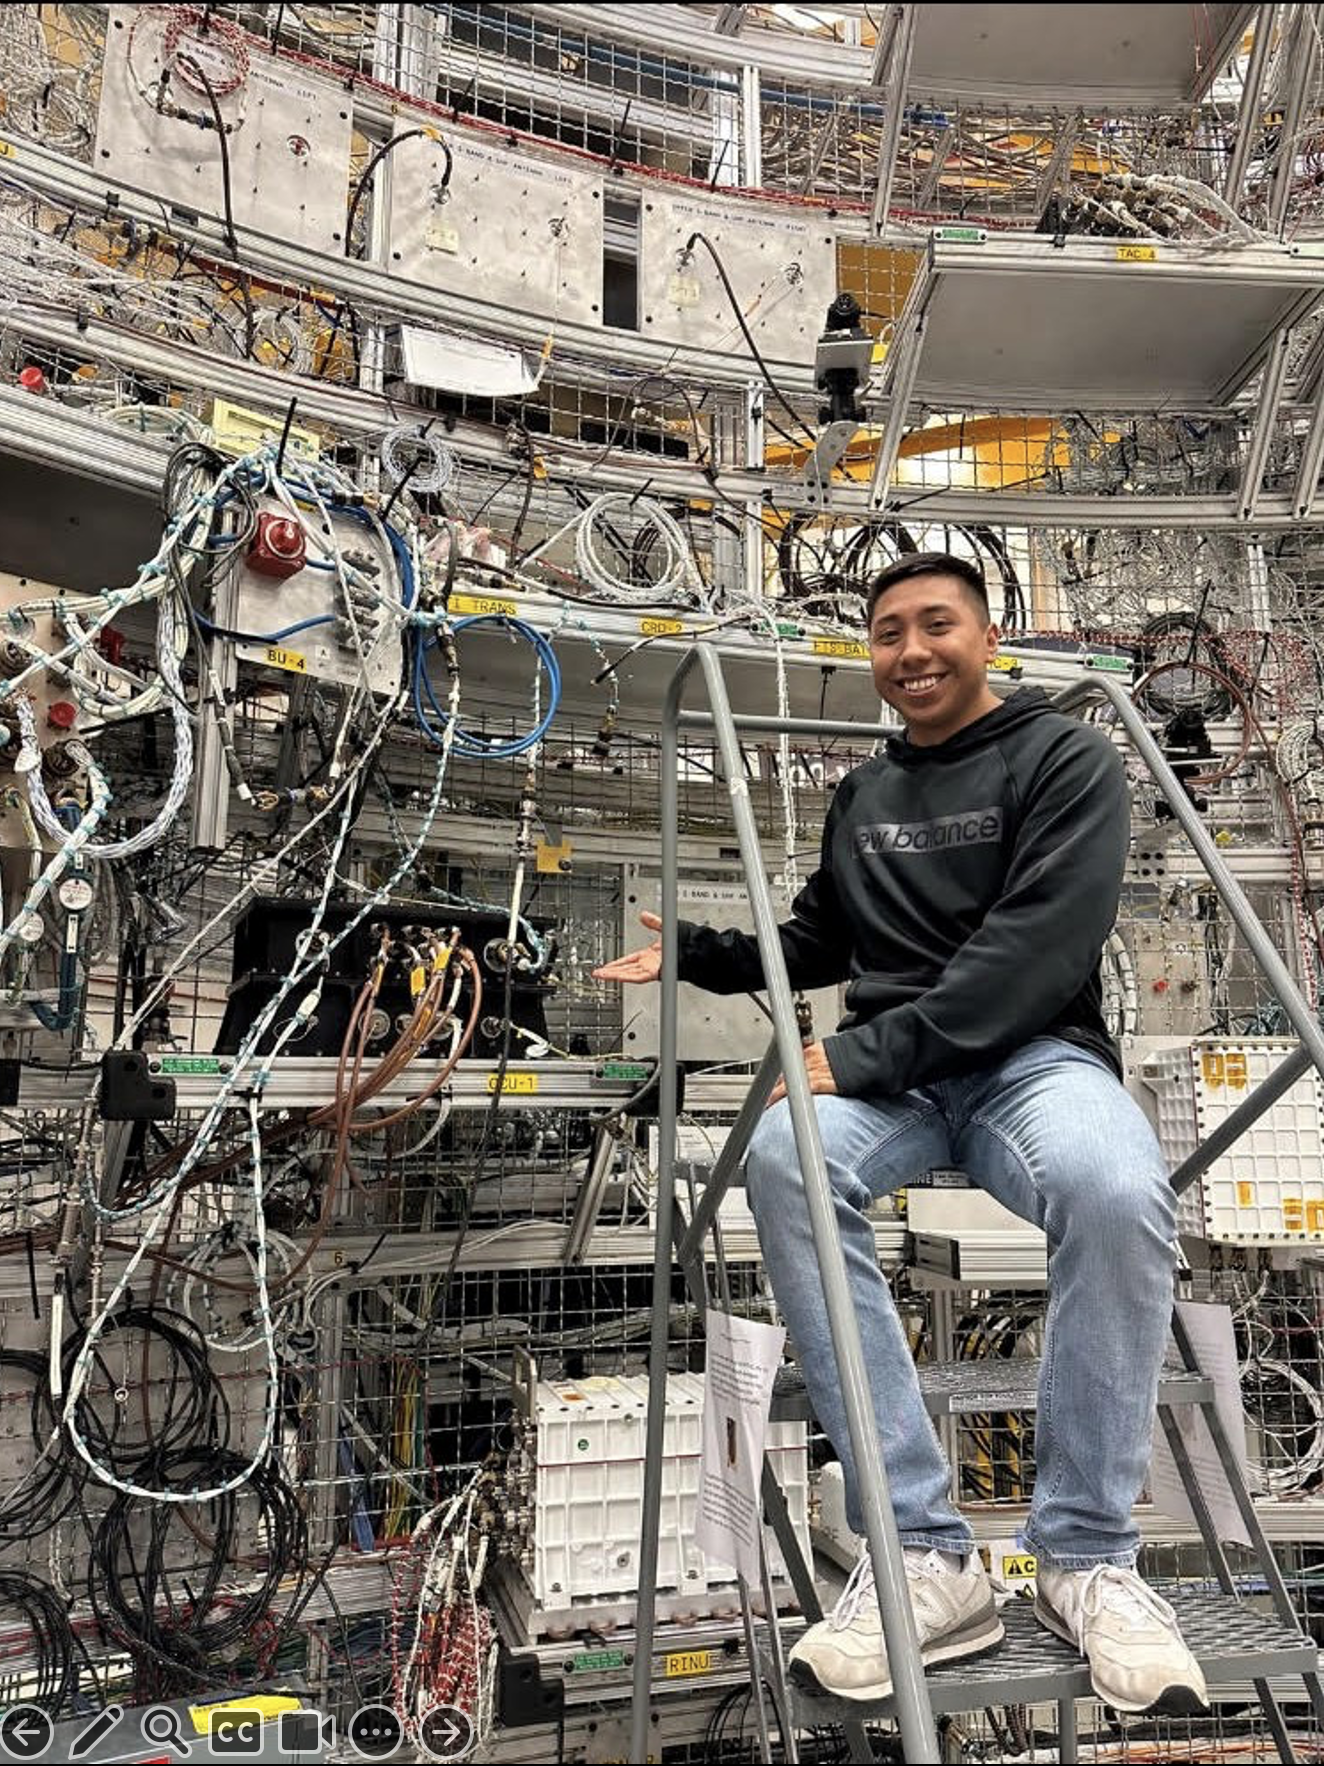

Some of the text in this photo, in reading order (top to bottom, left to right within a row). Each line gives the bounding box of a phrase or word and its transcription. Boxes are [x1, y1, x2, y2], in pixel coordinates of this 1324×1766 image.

[267, 649, 305, 670] BU-4
[856, 829, 891, 851] ew
[669, 1653, 710, 1673] RINU
